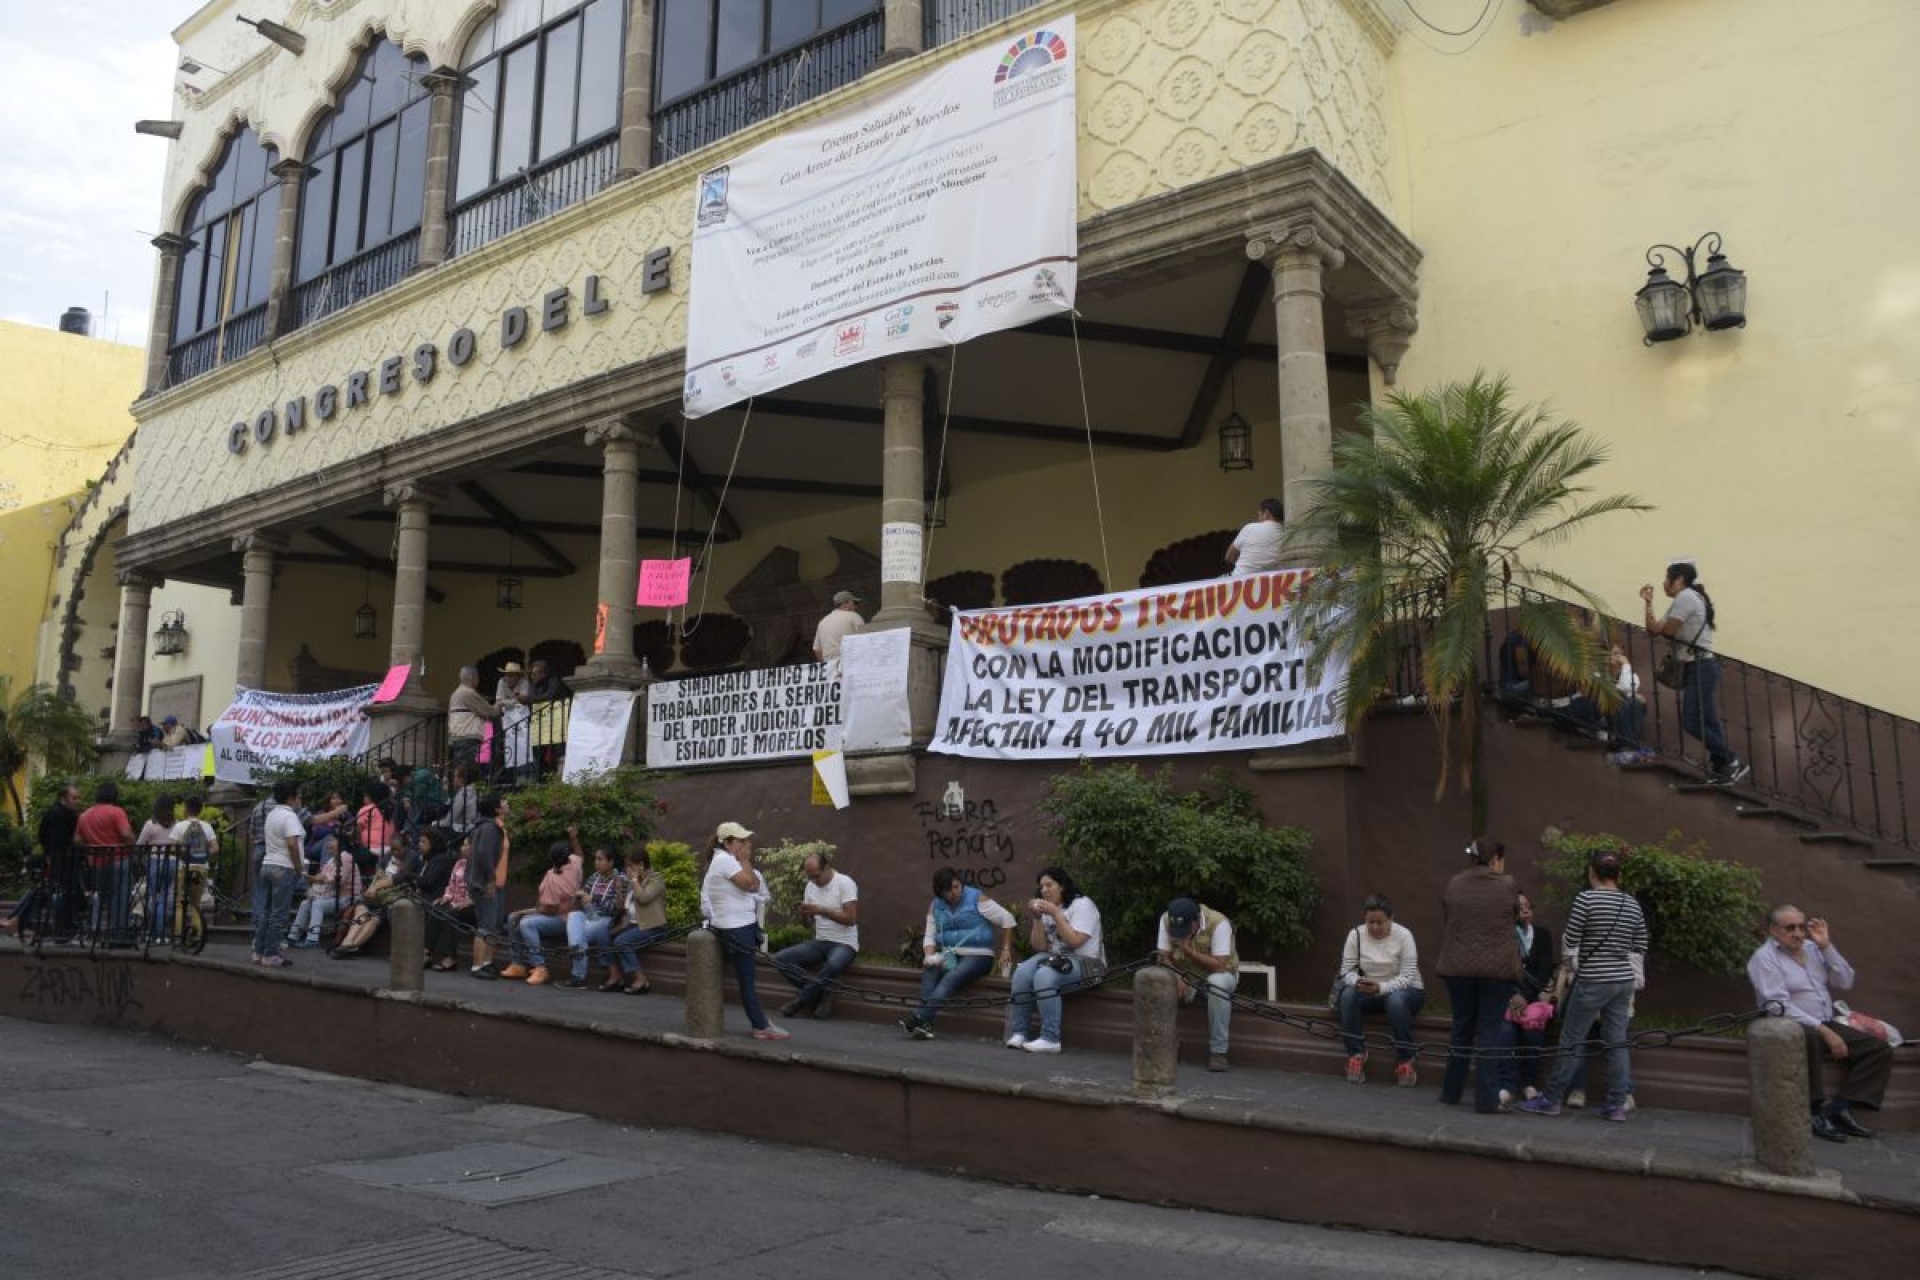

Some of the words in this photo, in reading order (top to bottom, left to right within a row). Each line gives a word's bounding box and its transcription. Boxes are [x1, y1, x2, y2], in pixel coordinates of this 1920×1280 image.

[229, 328, 476, 454] CONGRESO
[501, 275, 609, 348] DEL
[972, 652, 1027, 679] CON
[1032, 650, 1065, 679] LA
[1073, 621, 1289, 676] MODIFICACION
[677, 672, 751, 699] SINDICATO
[808, 661, 828, 682] DE
[964, 684, 993, 713] LA
[1002, 687, 1056, 714] LEY
[1062, 683, 1115, 713] DEL
[1123, 659, 1303, 708] TRANSPORT
[652, 690, 758, 723] TRABAJADORES
[762, 688, 780, 710] AL
[786, 682, 841, 708] SERVIC
[941, 716, 1055, 750] AFECTAN
[1062, 719, 1087, 748] A
[1094, 717, 1139, 748] 40
[1147, 710, 1199, 744] MIL
[1208, 690, 1340, 741] FAMILIAS
[252, 731, 281, 748] LOS
[663, 722, 687, 742] DEL
[692, 716, 737, 739] PODER
[741, 707, 807, 734] JUDICIAL
[813, 704, 843, 727] DEL
[220, 747, 233, 761] AL
[676, 737, 726, 762] ESTADO
[731, 735, 748, 756] DE
[753, 728, 827, 755] MORELOS
